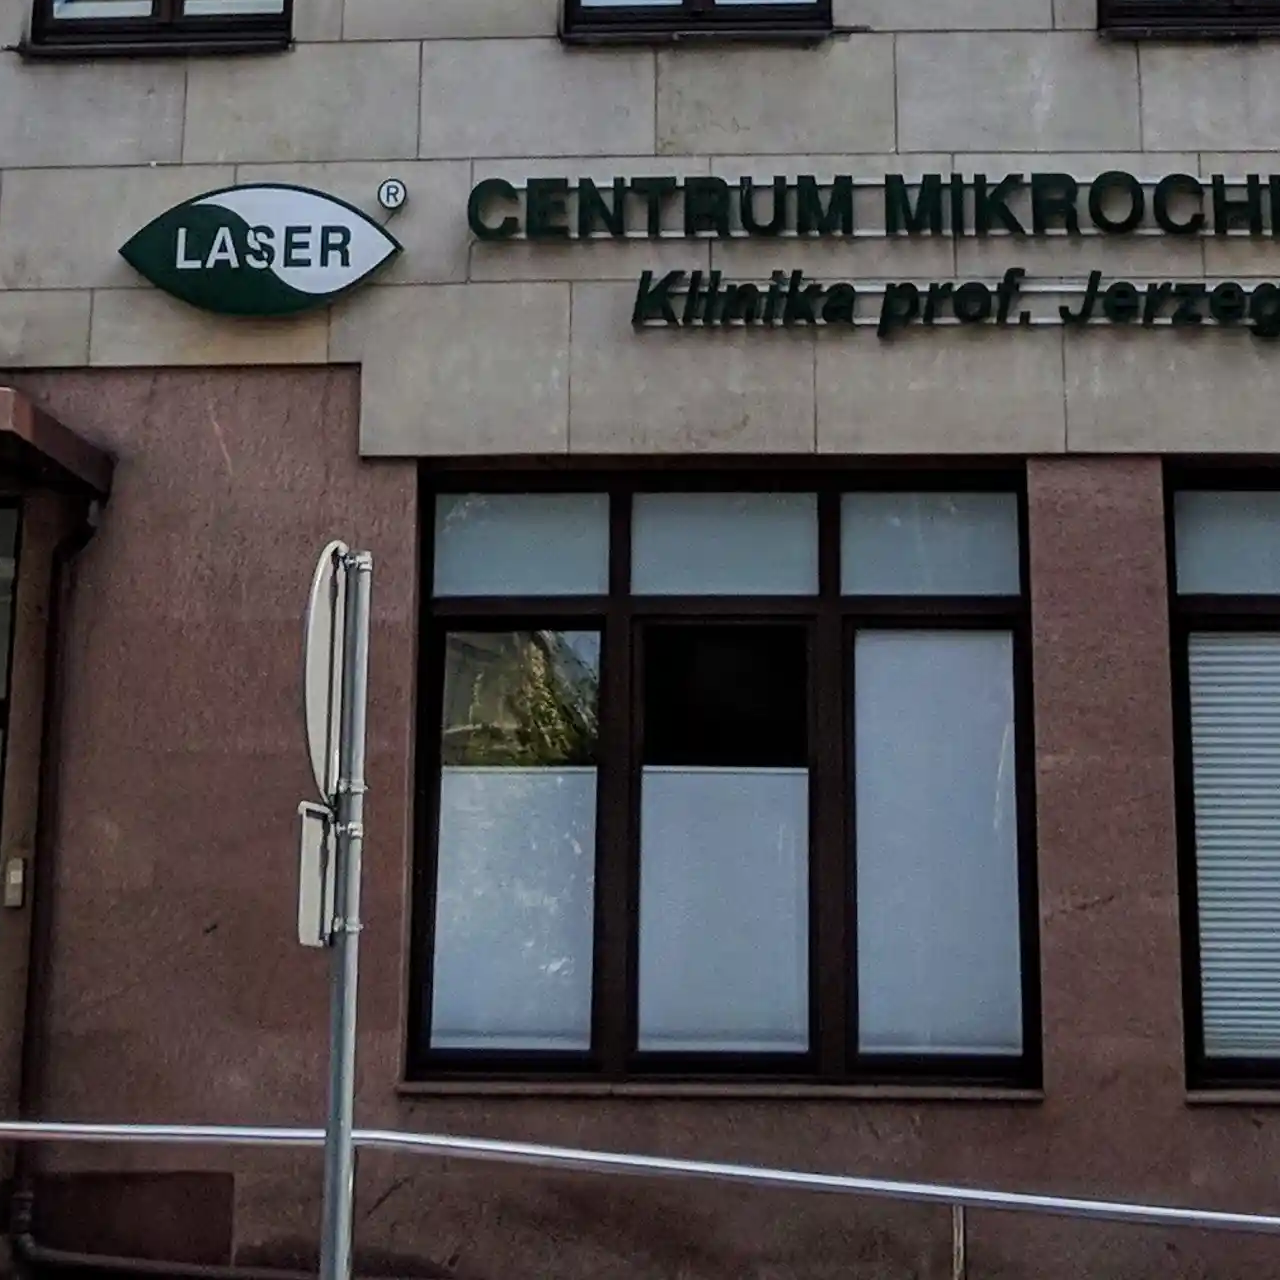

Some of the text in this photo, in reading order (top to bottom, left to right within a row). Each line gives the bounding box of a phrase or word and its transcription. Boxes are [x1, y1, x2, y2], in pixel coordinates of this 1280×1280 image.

[467, 174, 855, 241] CENTRUM
[174, 224, 353, 271] LASER
[630, 268, 856, 330] Klinika
[878, 266, 1032, 337] prof.
